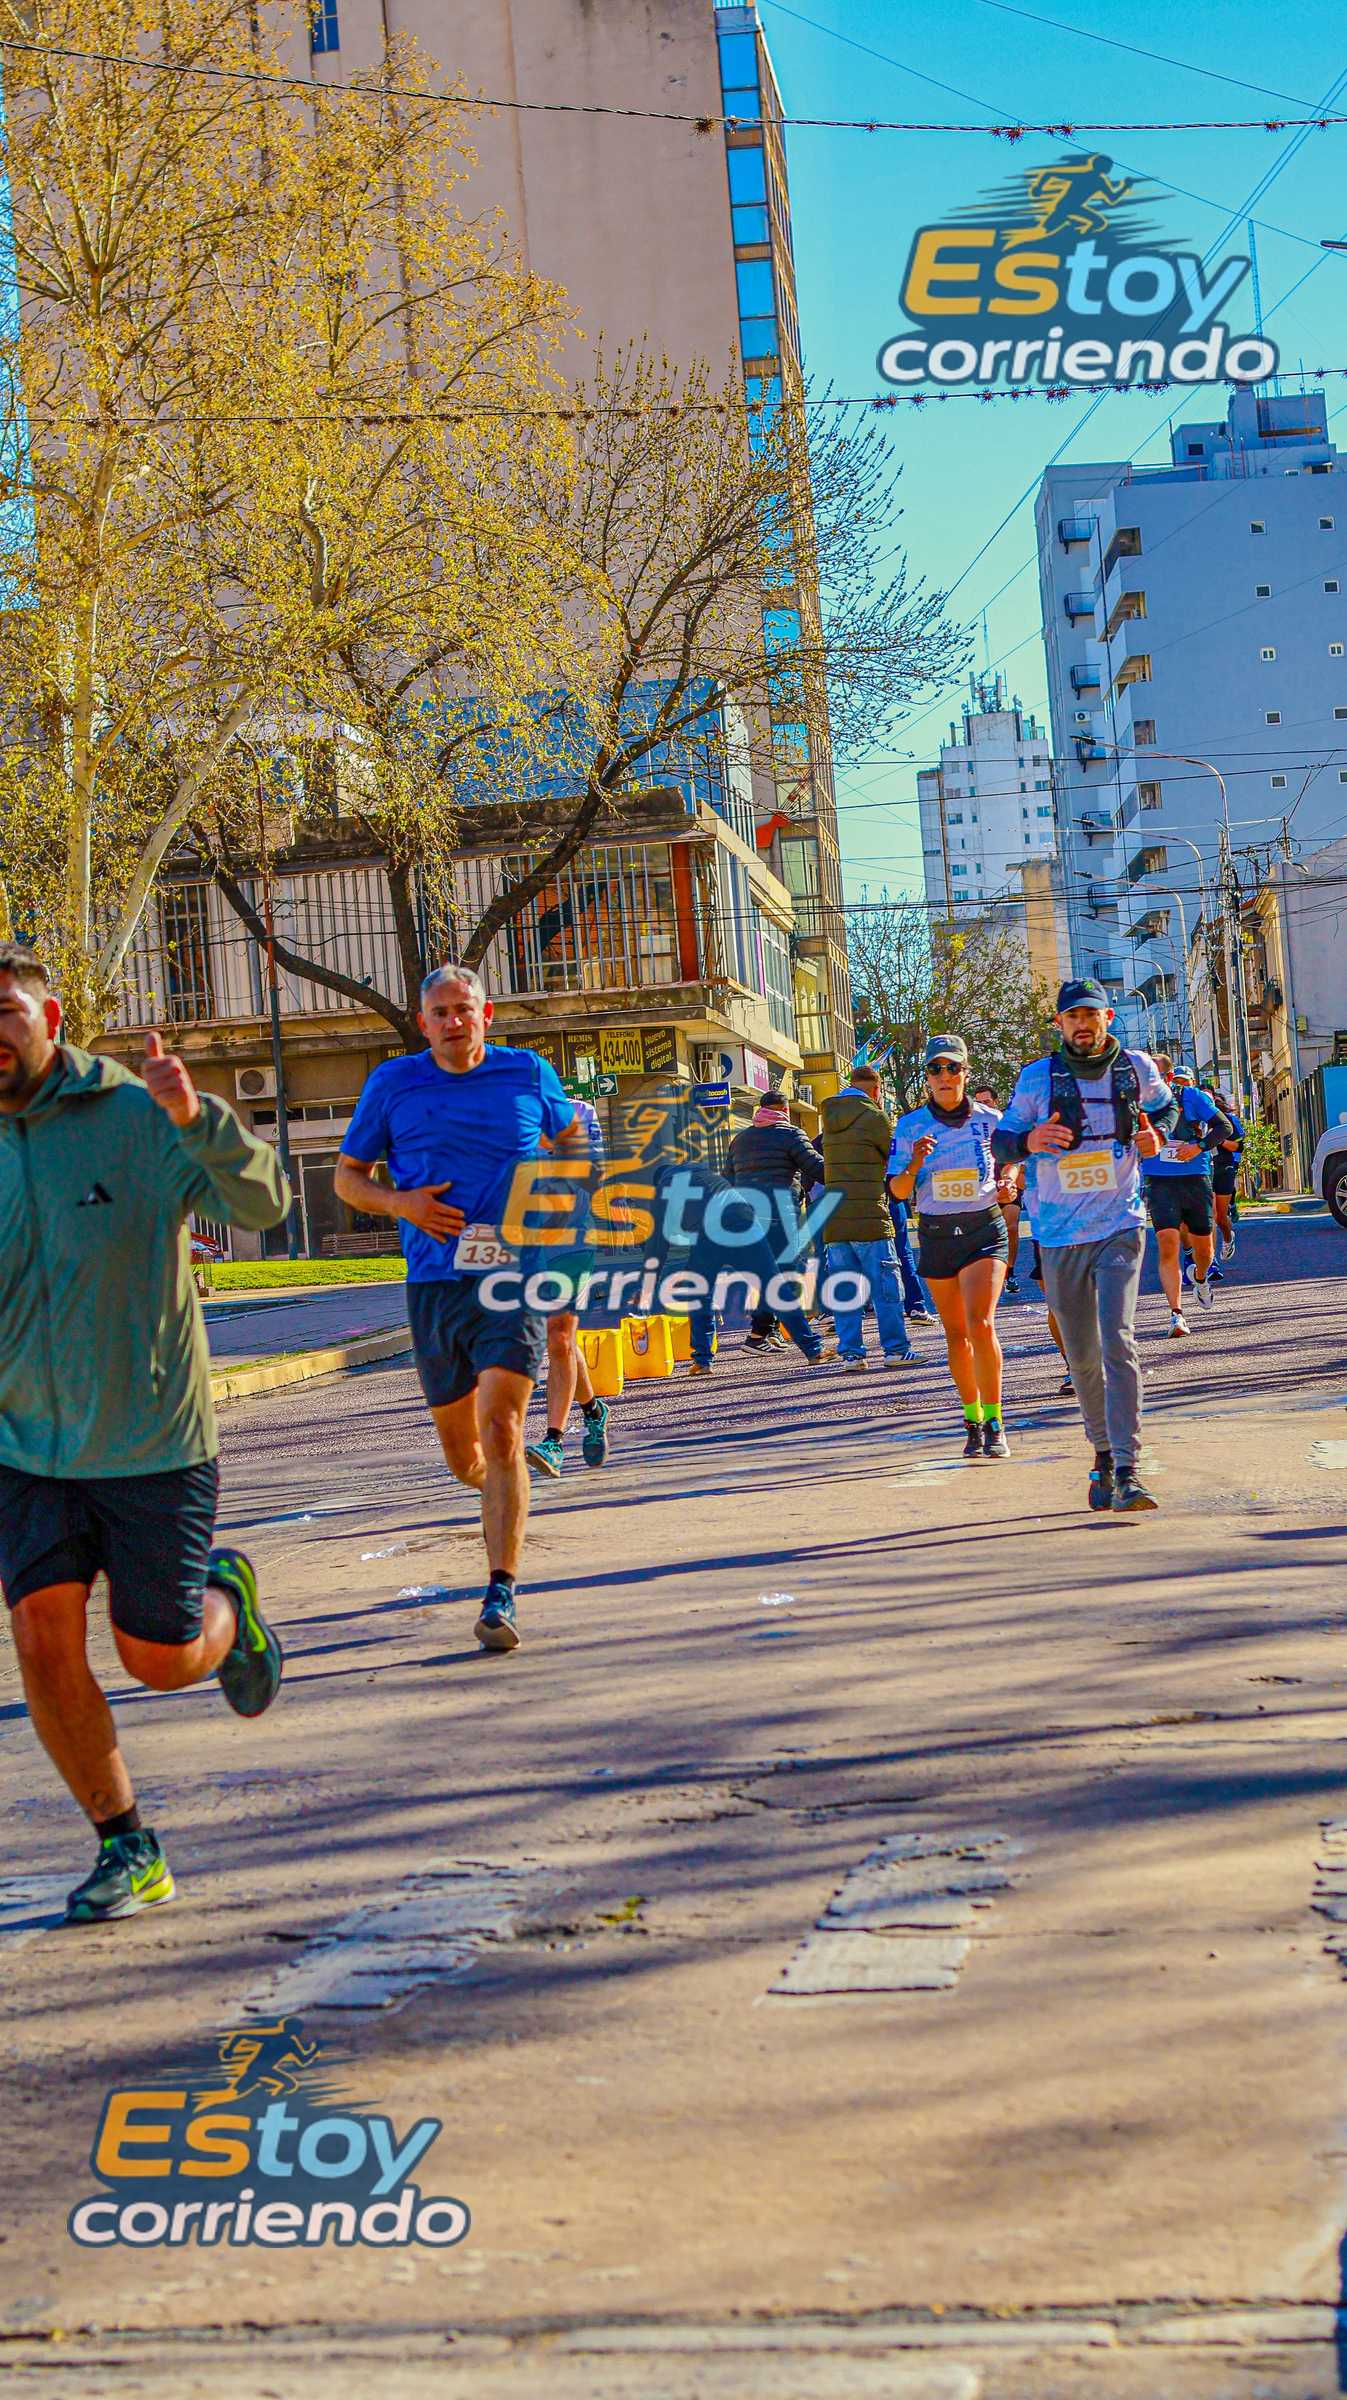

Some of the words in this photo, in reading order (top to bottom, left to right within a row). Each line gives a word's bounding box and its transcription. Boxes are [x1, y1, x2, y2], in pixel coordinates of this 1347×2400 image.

[645, 1039, 673, 1060] sistema
[1065, 1167, 1109, 1189] 259
[939, 1182, 974, 1198] 398
[463, 1245, 512, 1265] 135
